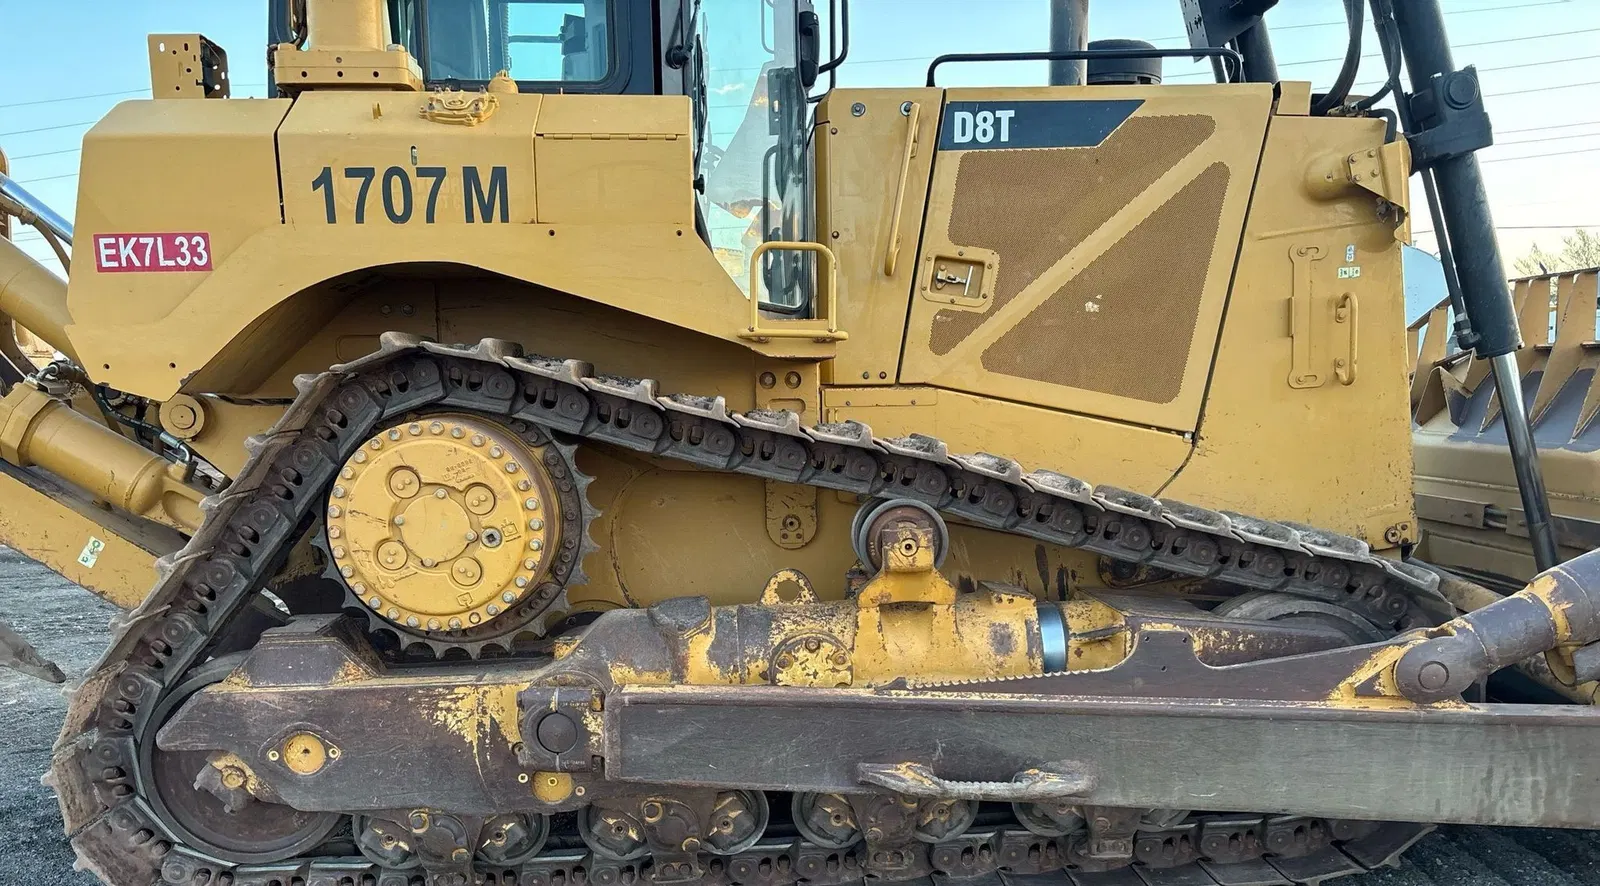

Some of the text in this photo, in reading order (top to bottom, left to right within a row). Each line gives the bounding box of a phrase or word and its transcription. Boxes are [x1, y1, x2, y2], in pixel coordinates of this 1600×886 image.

[953, 110, 1015, 143] D8T
[312, 166, 447, 224] 1707
[462, 166, 509, 224] M
[99, 236, 207, 267] EK7L33
